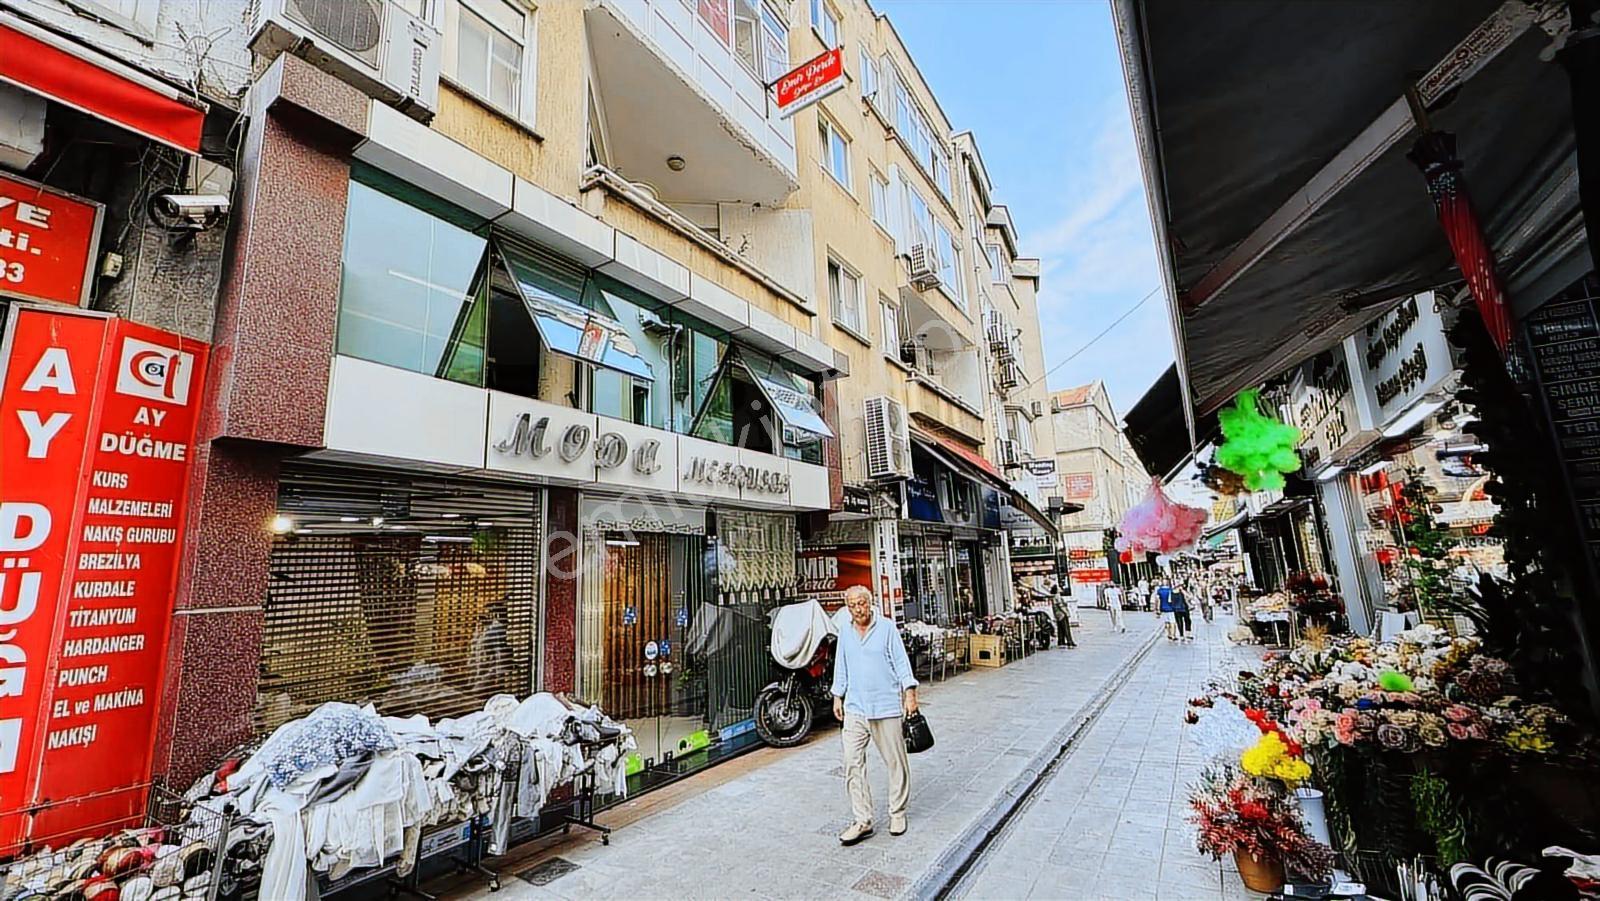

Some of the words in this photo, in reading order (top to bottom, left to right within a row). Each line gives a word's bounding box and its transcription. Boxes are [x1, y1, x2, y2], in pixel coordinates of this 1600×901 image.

[133, 406, 167, 427] AY
[101, 431, 187, 461] DÜĞME
[93, 470, 128, 489] KURS
[88, 498, 173, 518] MALZEMELERİ
[84, 525, 124, 546] NAKIŞ
[126, 527, 176, 544] GURUBU
[78, 549, 141, 570] BREZİLYA
[74, 580, 136, 599] KURDALE
[69, 606, 137, 628] TİTANYUM
[63, 634, 145, 658] HARDANGER
[58, 665, 108, 688] PUNCH
[53, 699, 70, 718] EL
[74, 700, 91, 715] ve
[93, 686, 144, 712] MAKİNA
[48, 723, 98, 750] NAKIŞI
